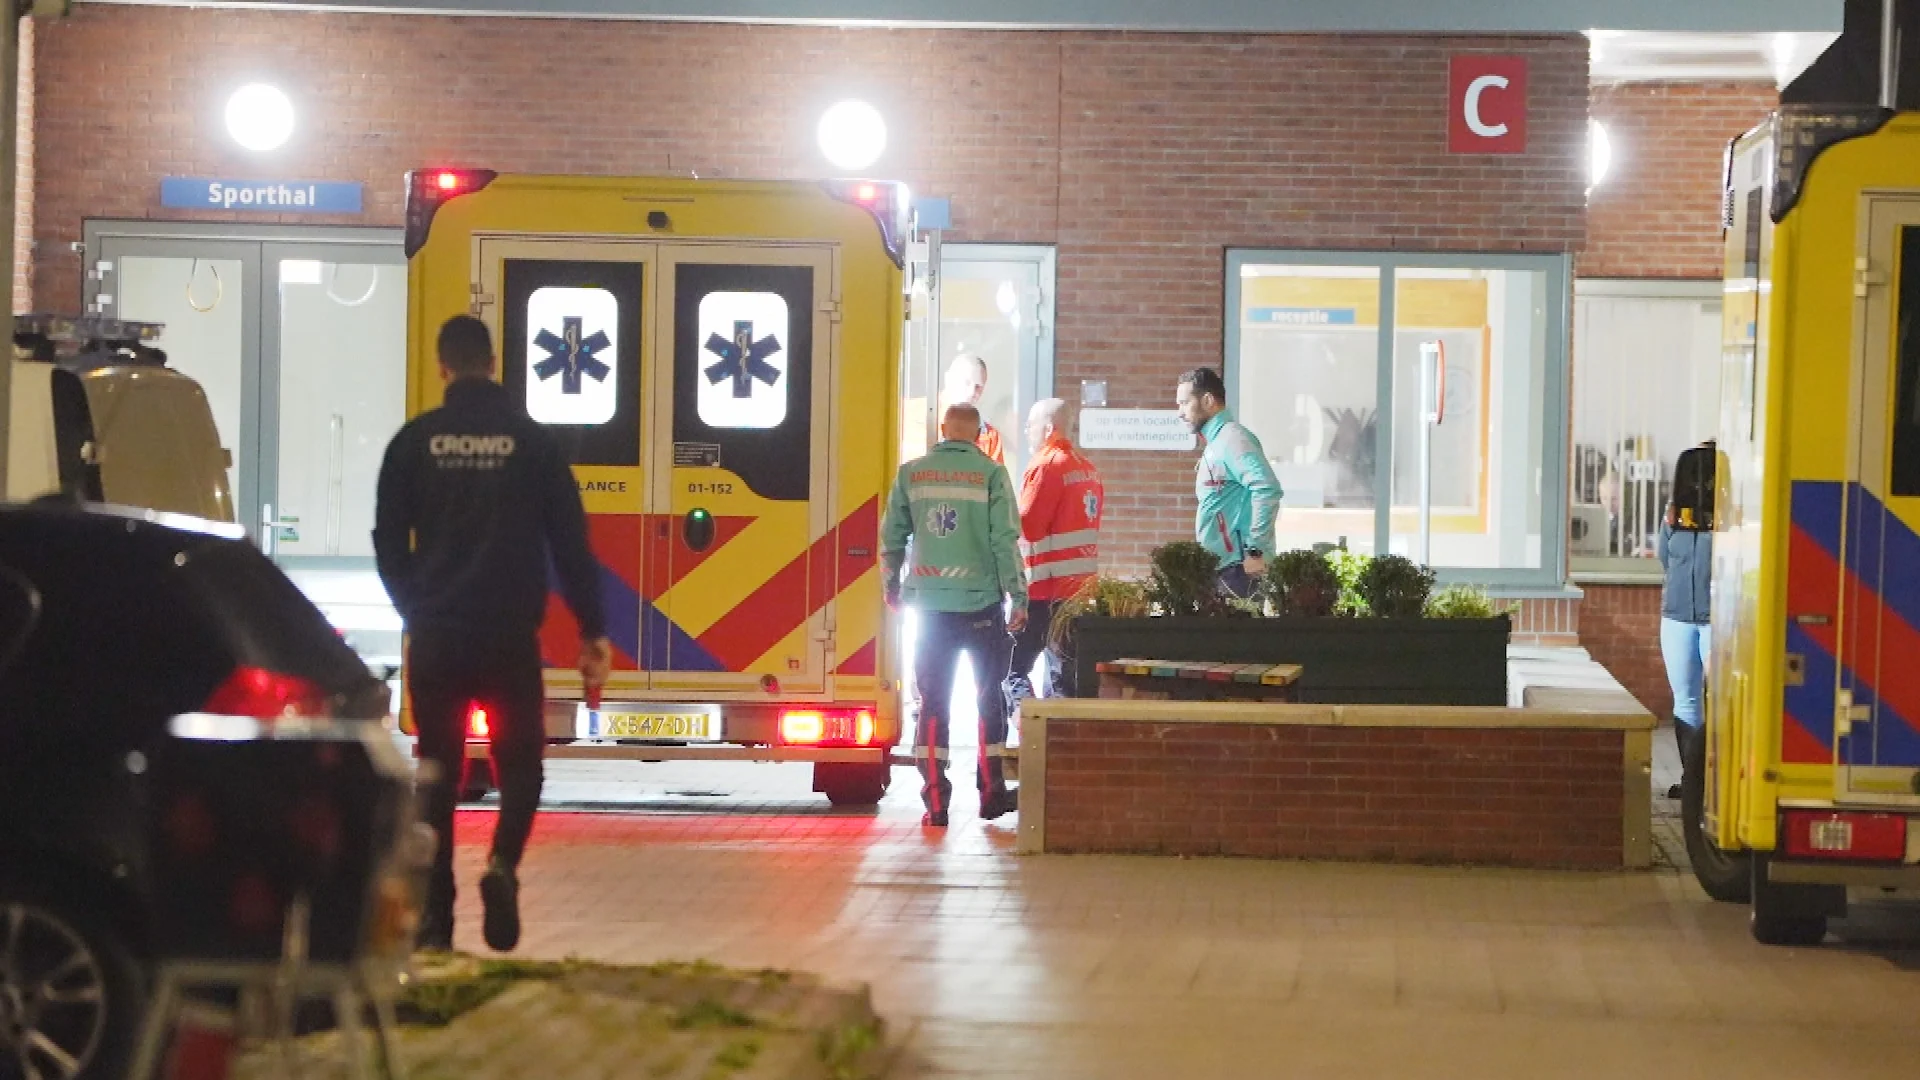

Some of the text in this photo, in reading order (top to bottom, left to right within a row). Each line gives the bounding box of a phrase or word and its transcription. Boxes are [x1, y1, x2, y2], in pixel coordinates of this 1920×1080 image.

[1463, 75, 1509, 137] C
[208, 182, 316, 209] Sporthal
[1143, 414, 1181, 426] locatie
[429, 434, 515, 456] CROWD
[577, 481, 627, 493] LANCE
[688, 483, 733, 495] 01-152
[606, 715, 702, 736] X-547-DH
